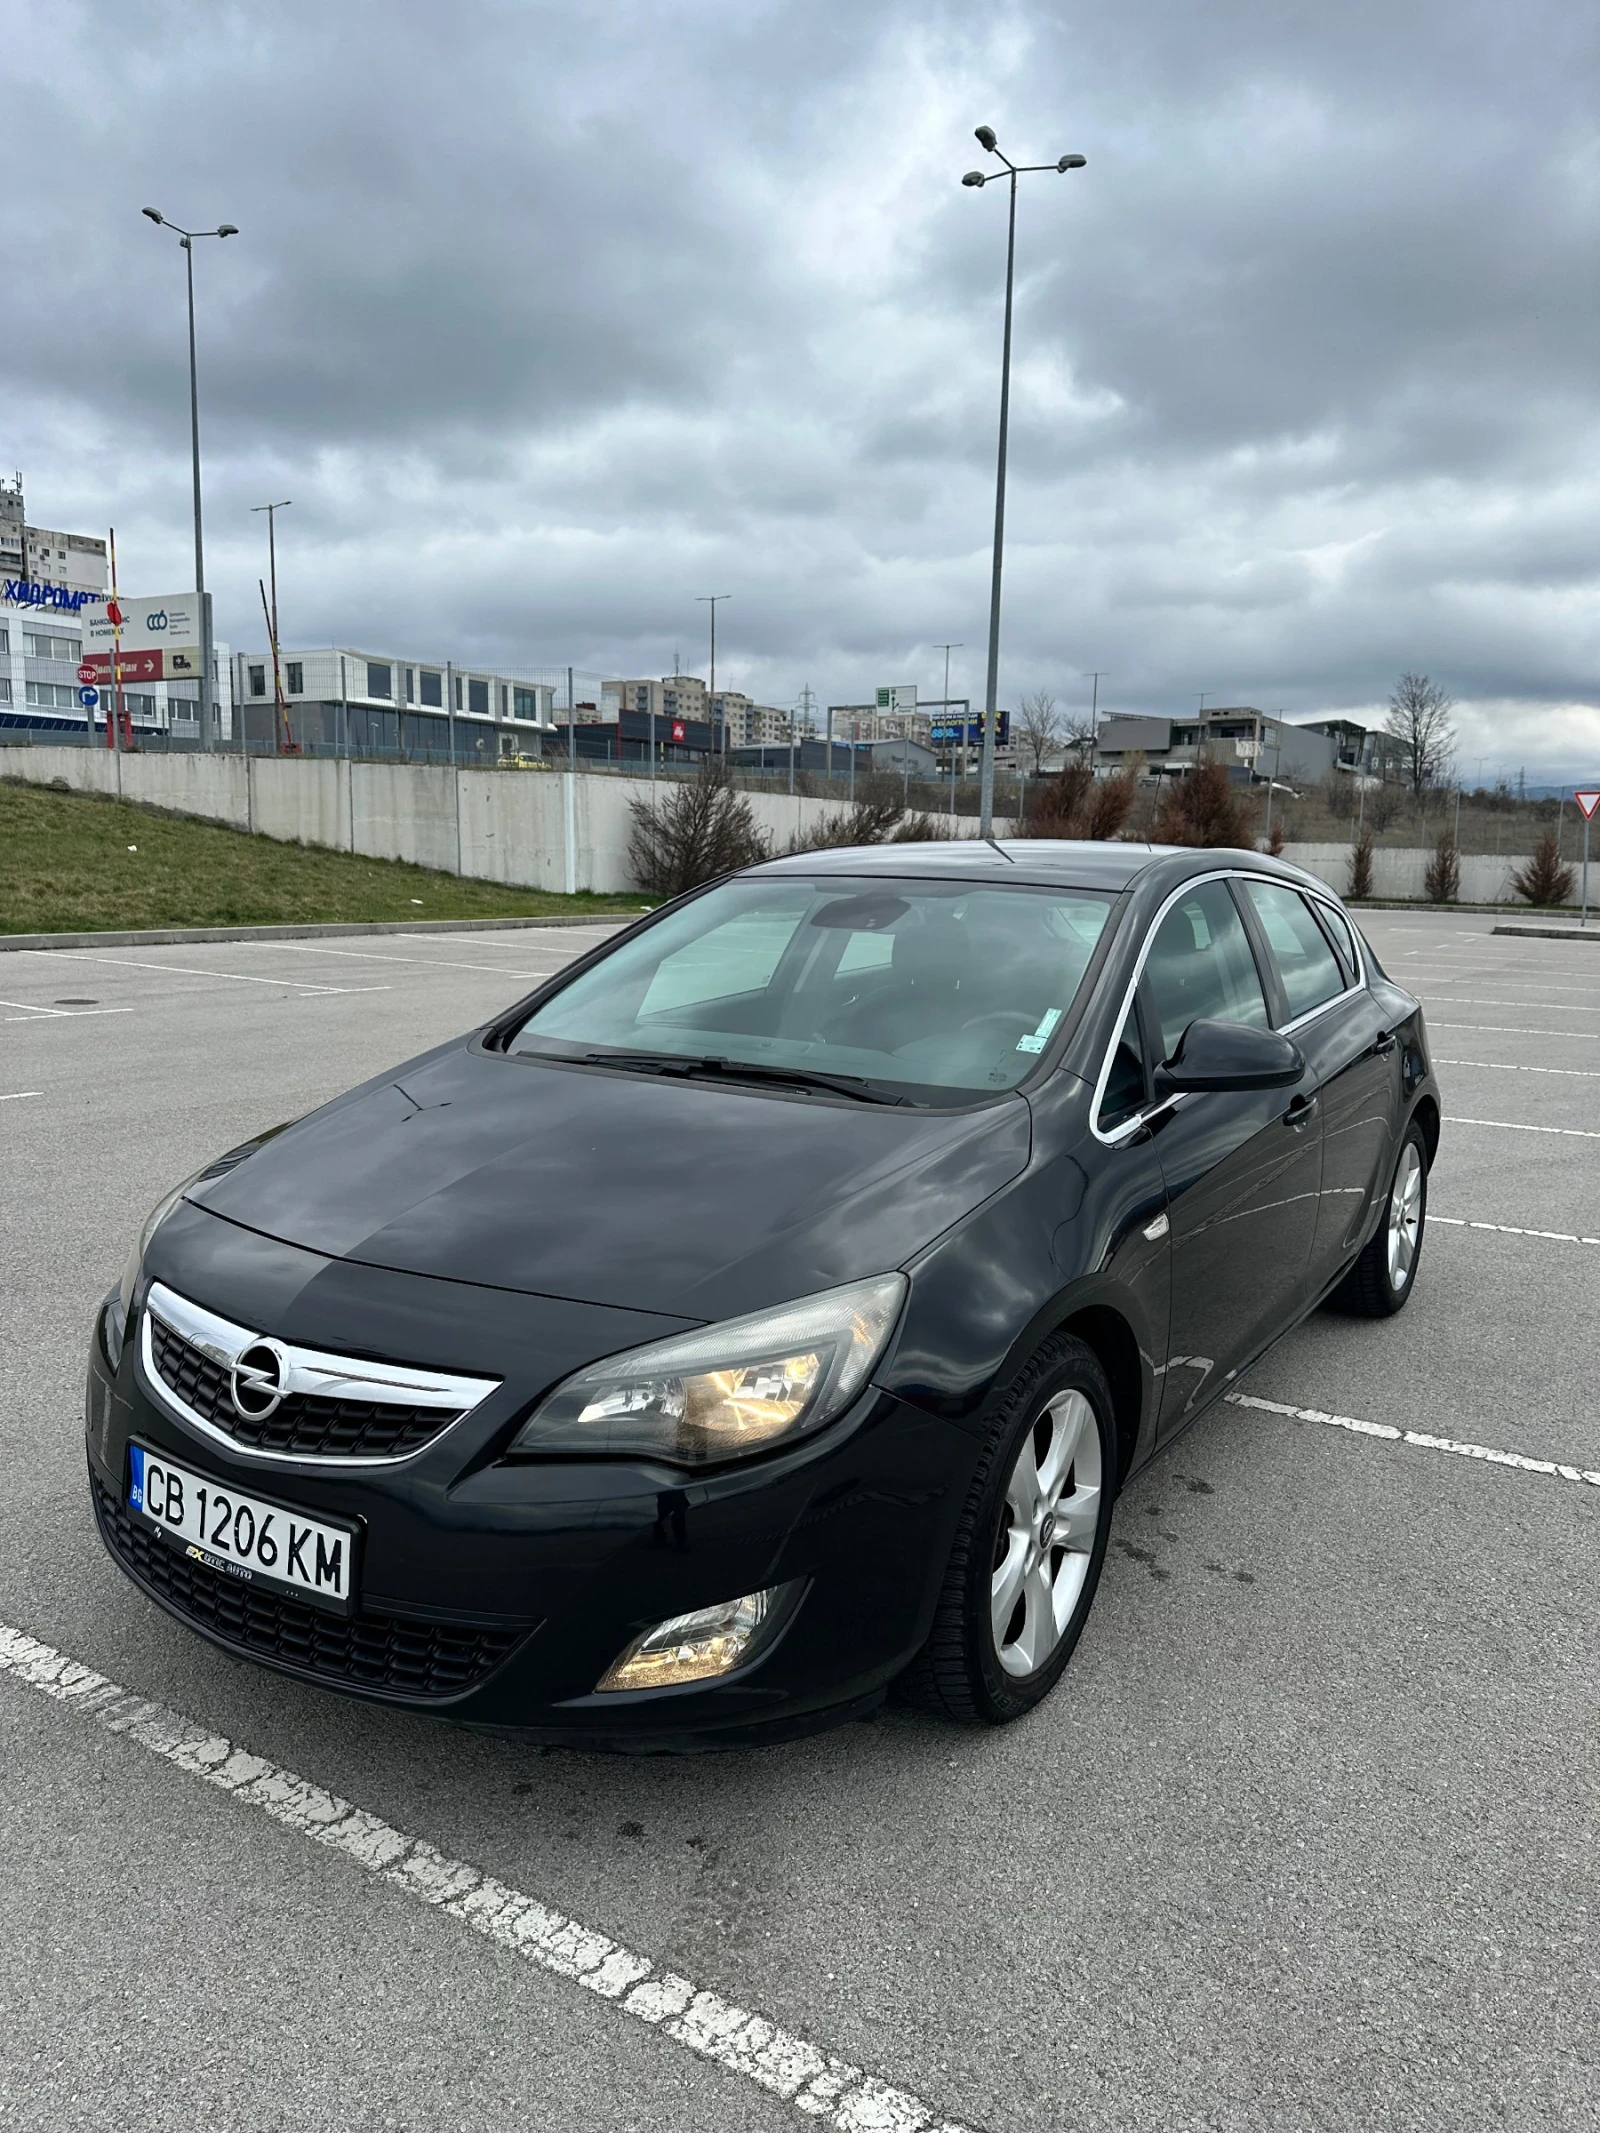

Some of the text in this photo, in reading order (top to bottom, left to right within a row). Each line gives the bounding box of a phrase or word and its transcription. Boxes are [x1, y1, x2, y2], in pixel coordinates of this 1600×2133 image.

[78, 670, 96, 679] STOP
[132, 1484, 143, 1503] BG
[147, 1464, 342, 1593] CB 1206 KM
[226, 1563, 253, 1580] AUTO
